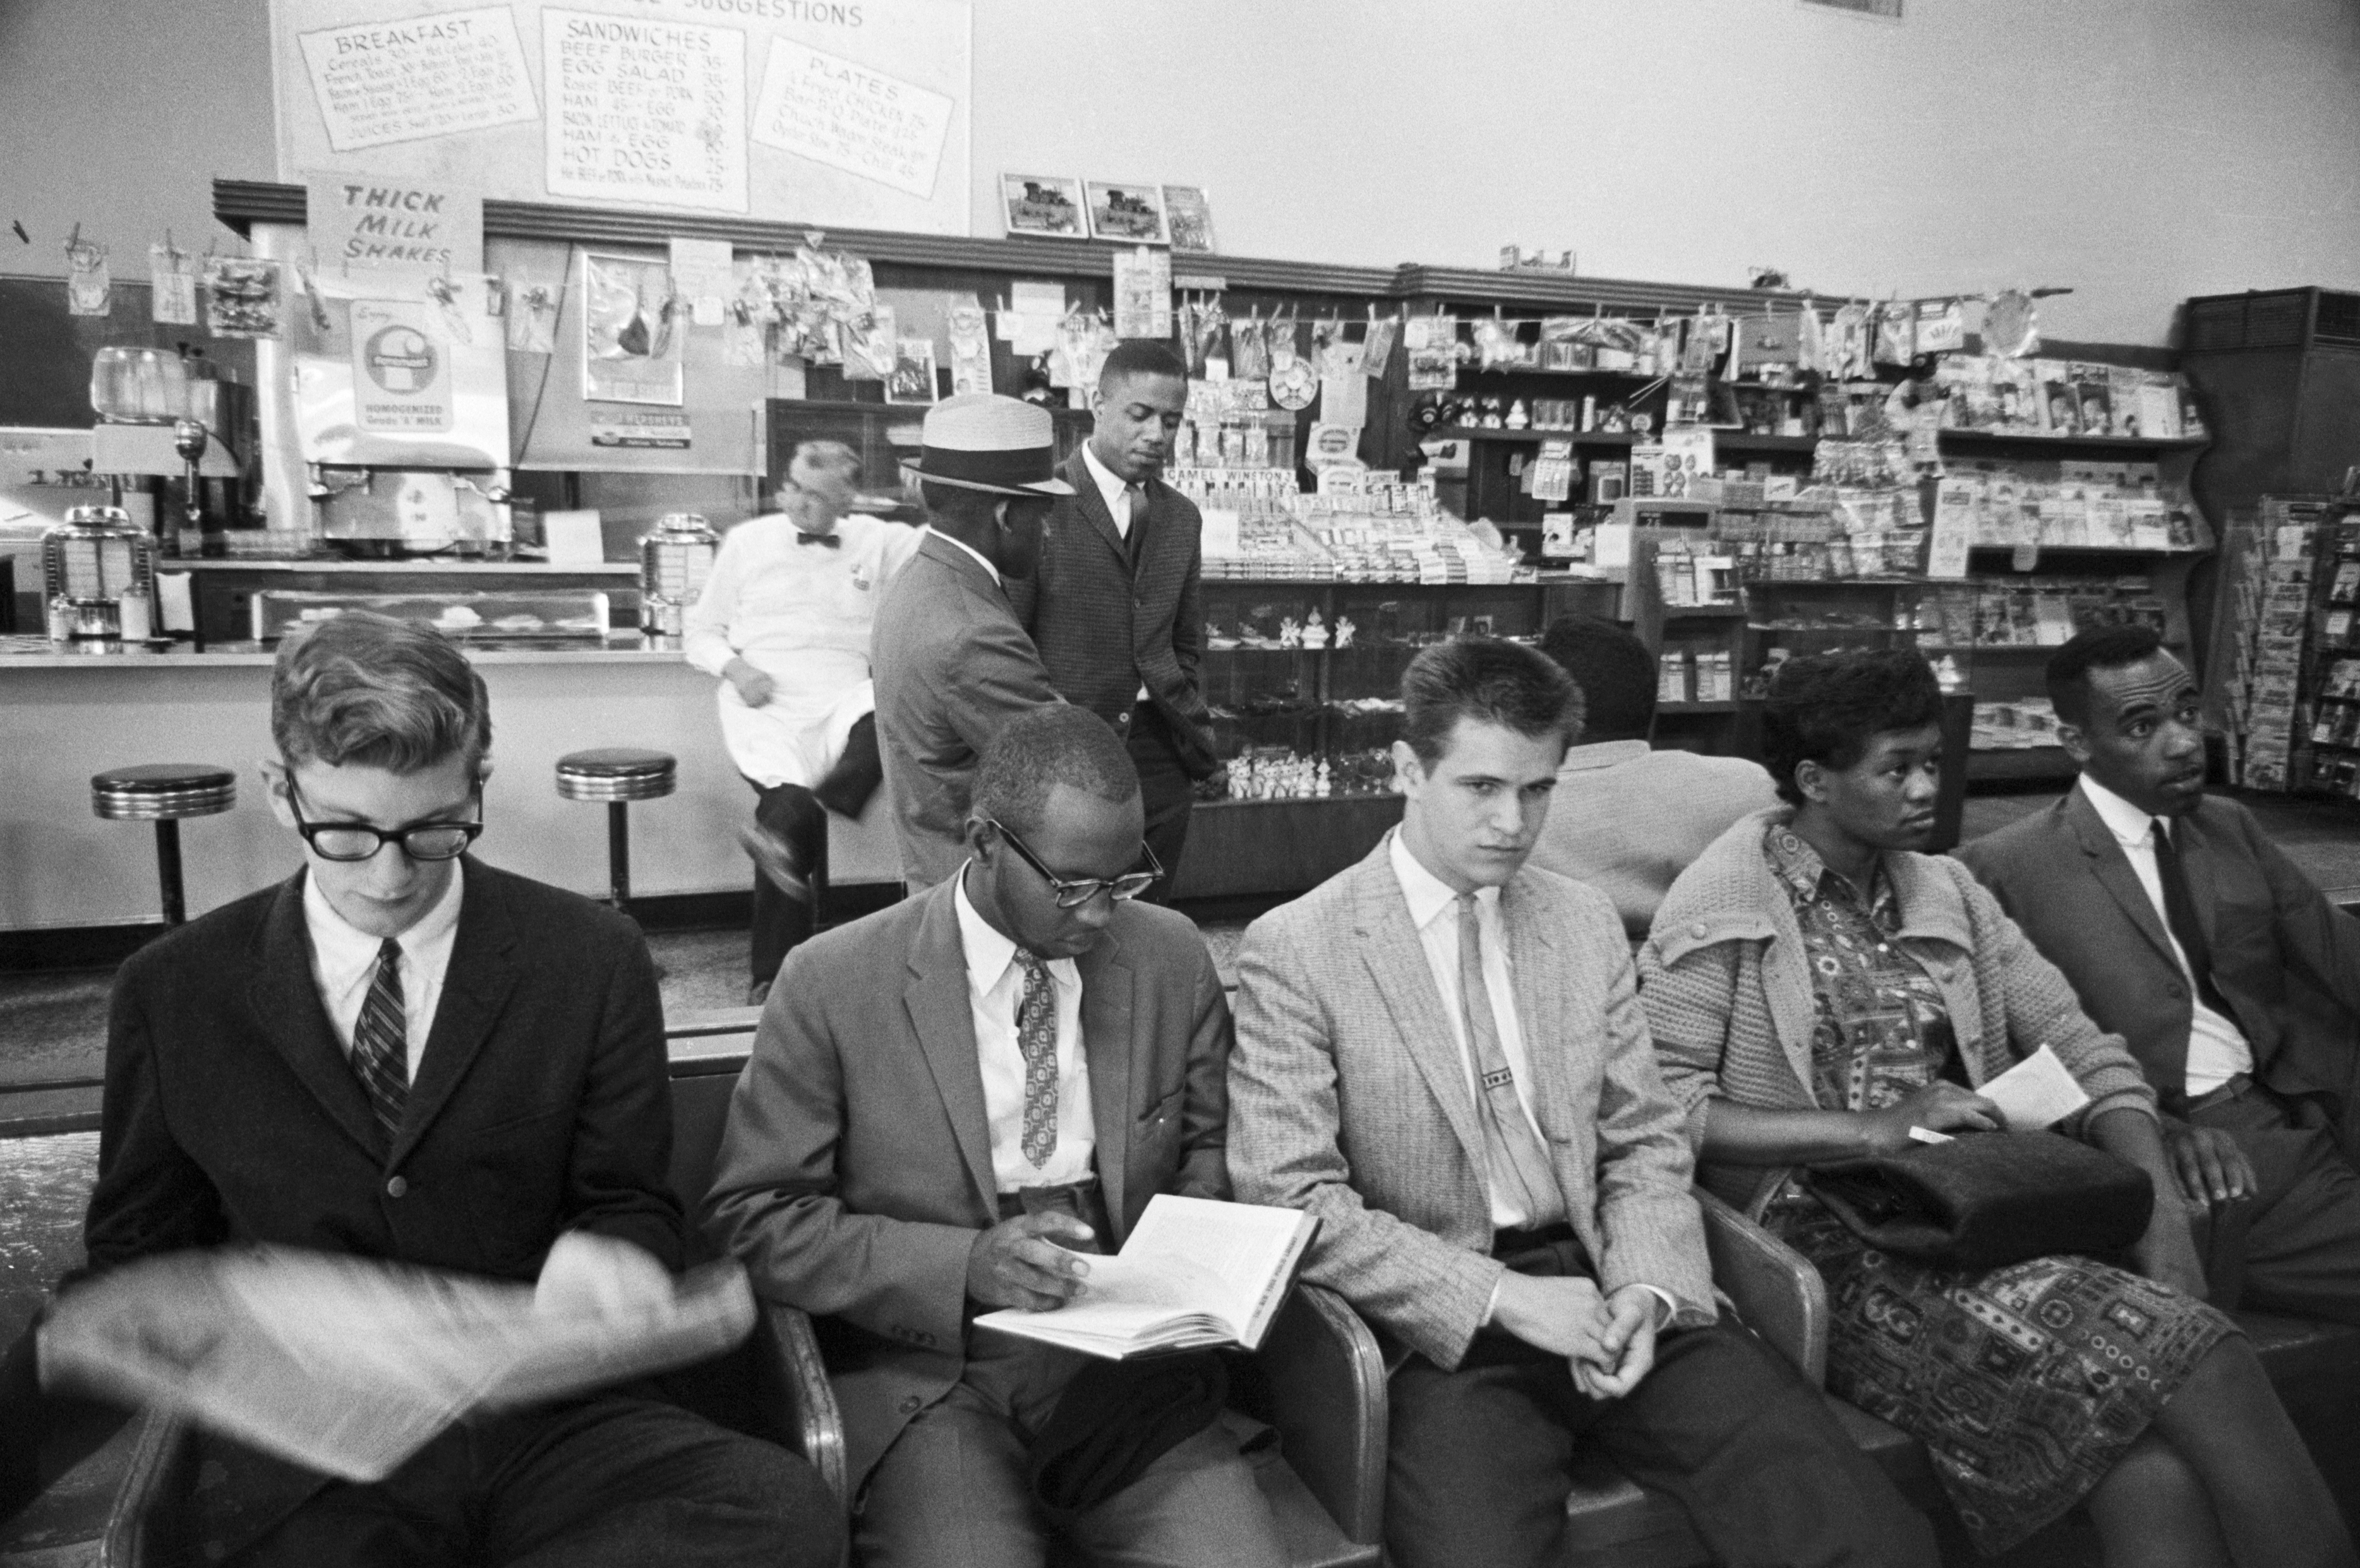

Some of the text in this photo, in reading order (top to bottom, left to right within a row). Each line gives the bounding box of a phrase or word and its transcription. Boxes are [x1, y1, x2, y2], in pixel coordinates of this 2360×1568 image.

[335, 19, 472, 54] BREAKFAST
[567, 19, 710, 51] SANDWICHES
[560, 39, 610, 57] BEEF
[620, 45, 687, 67] BURGER
[561, 57, 605, 75] EGG
[617, 63, 685, 83] SALAD
[809, 56, 898, 101] PLATES
[562, 93, 598, 107] HAM
[607, 79, 642, 96] BEEF
[845, 92, 903, 123] CHICKEN
[562, 129, 601, 142] HAM
[628, 133, 670, 150] EGG
[562, 145, 600, 164] HOT
[613, 148, 671, 171] DOGS
[344, 184, 445, 213] THICK
[354, 213, 438, 239] MILK
[344, 237, 451, 263] SHAKES
[365, 404, 443, 414] HOMOGENIZED
[416, 416, 442, 426] MILK
[1167, 469, 1216, 481] CAMEL
[1226, 470, 1282, 481] WINSTON
